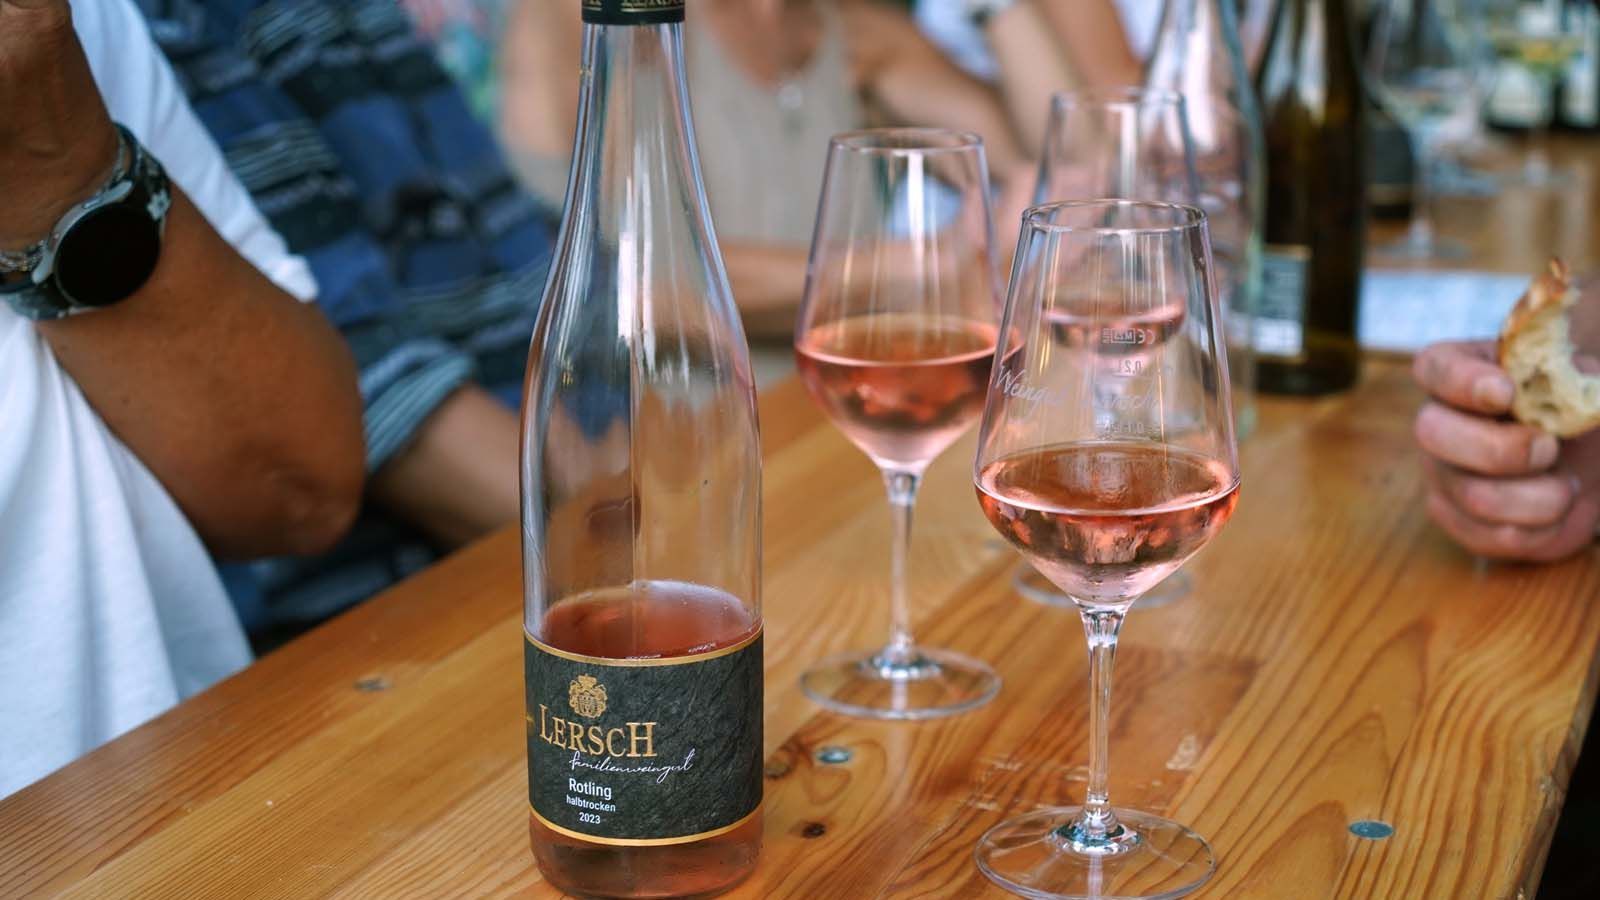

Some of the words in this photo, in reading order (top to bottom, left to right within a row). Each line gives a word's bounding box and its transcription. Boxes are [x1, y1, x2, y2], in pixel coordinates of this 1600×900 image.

[538, 703, 658, 758] LERSCH
[568, 748, 696, 784] familienweingut
[568, 777, 612, 801] Rotling
[566, 794, 616, 813] halbtrocken
[578, 811, 601, 825] 2023
